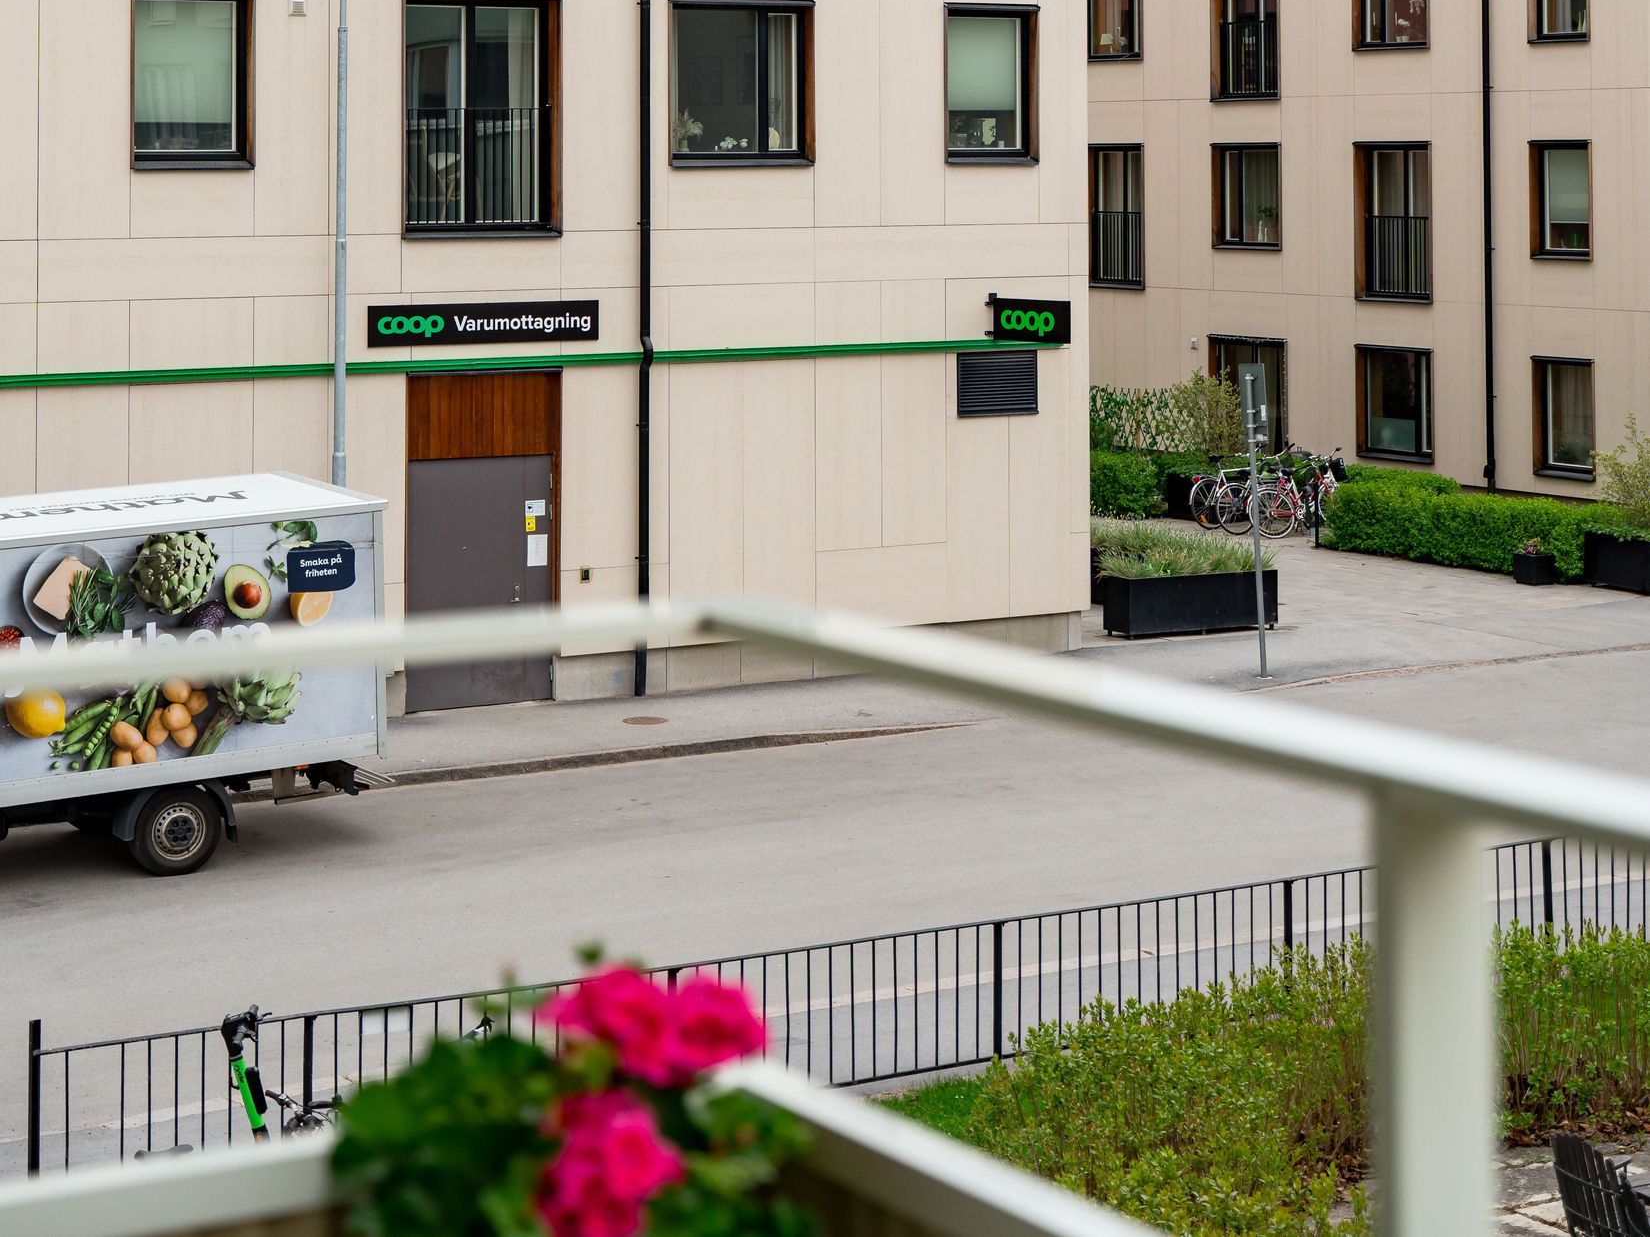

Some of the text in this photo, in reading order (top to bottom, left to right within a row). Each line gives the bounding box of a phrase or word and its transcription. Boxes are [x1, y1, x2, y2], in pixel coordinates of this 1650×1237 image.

[377, 312, 592, 338] coop Varumottagning
[1000, 309, 1055, 337] coop
[300, 553, 342, 568] Smaka på
[305, 568, 338, 578] friheten
